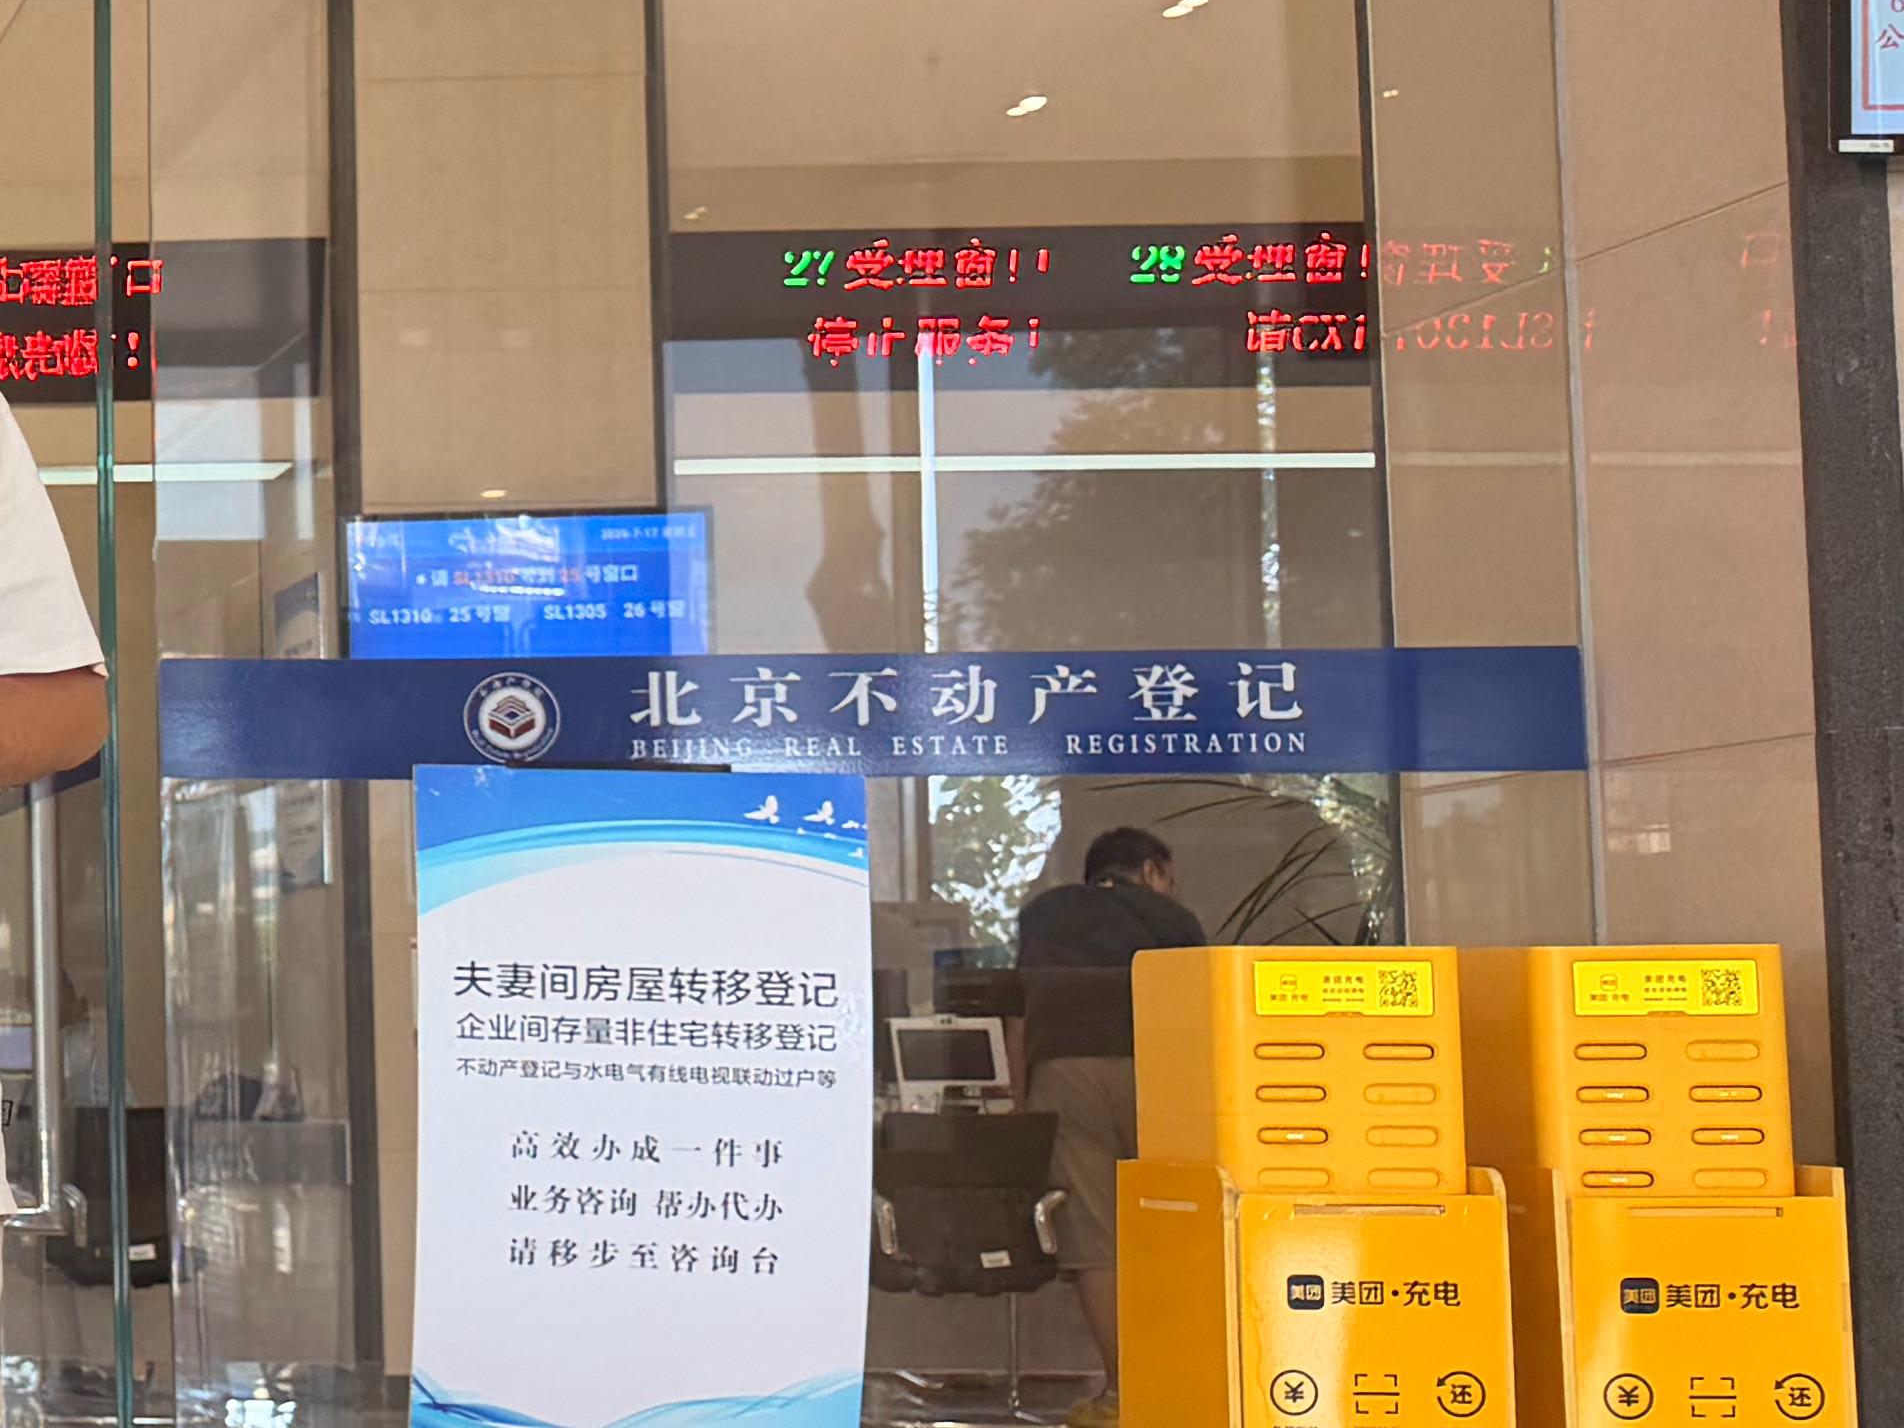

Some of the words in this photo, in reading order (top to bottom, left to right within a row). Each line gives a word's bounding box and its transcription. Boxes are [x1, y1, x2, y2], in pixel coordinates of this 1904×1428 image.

[628, 660, 1304, 727] 北京不动产登记
[630, 734, 755, 760] BEIJING
[782, 733, 862, 758] REAL
[890, 732, 1009, 757] ESTATE
[1065, 729, 1309, 755] REGISTRATION
[453, 960, 840, 1009] 夫妻间房屋转移登记
[456, 1012, 838, 1052] 企业间存量非住宅转移登记
[456, 1056, 837, 1090] 不动产登记与水电气有线电视联动过户等
[510, 1130, 784, 1169] 高效办成一件事
[509, 1184, 638, 1219] 业务咨询
[654, 1188, 785, 1222] 帮办代办
[509, 1237, 780, 1276] 请移步至咨询台
[1450, 1383, 1473, 1405] 还
[1788, 1386, 1812, 1407] 还
